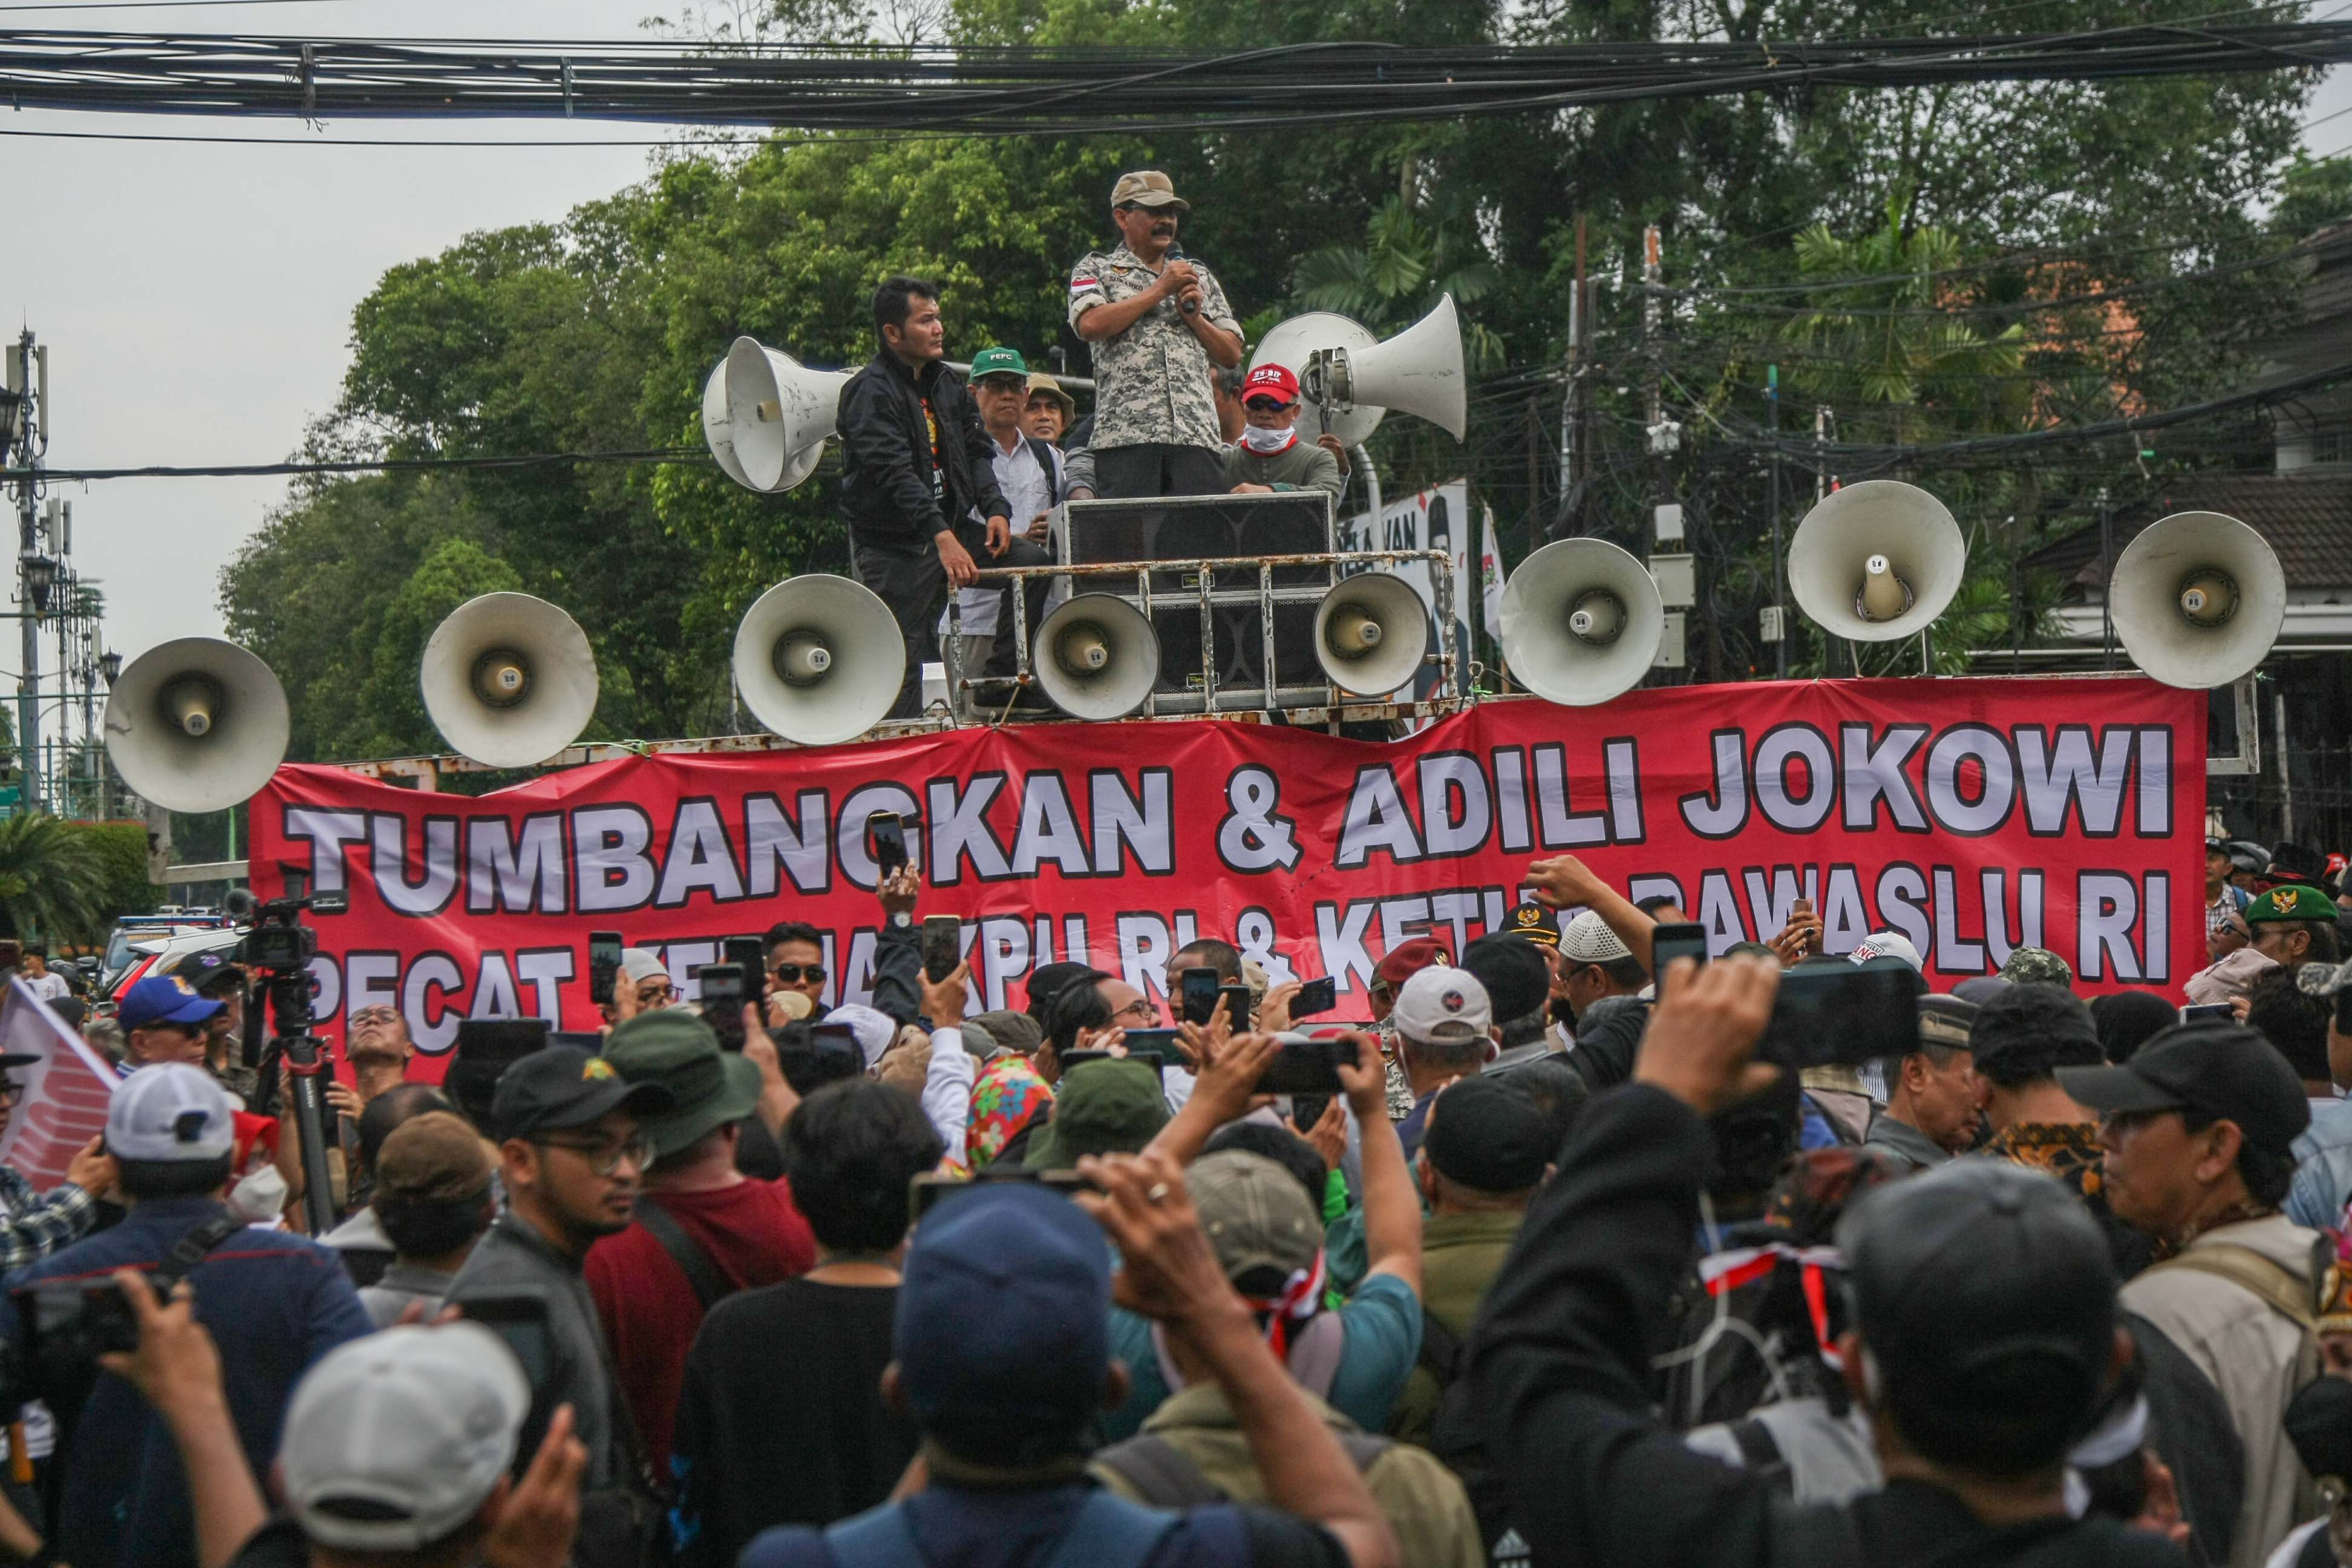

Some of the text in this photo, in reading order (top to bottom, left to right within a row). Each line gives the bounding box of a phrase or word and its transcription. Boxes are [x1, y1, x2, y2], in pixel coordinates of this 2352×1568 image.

[283, 720, 2174, 917] TUMBANGKAN & ADILI JOKOWI
[1236, 905, 1293, 990] &
[2076, 869, 2171, 984] RI
